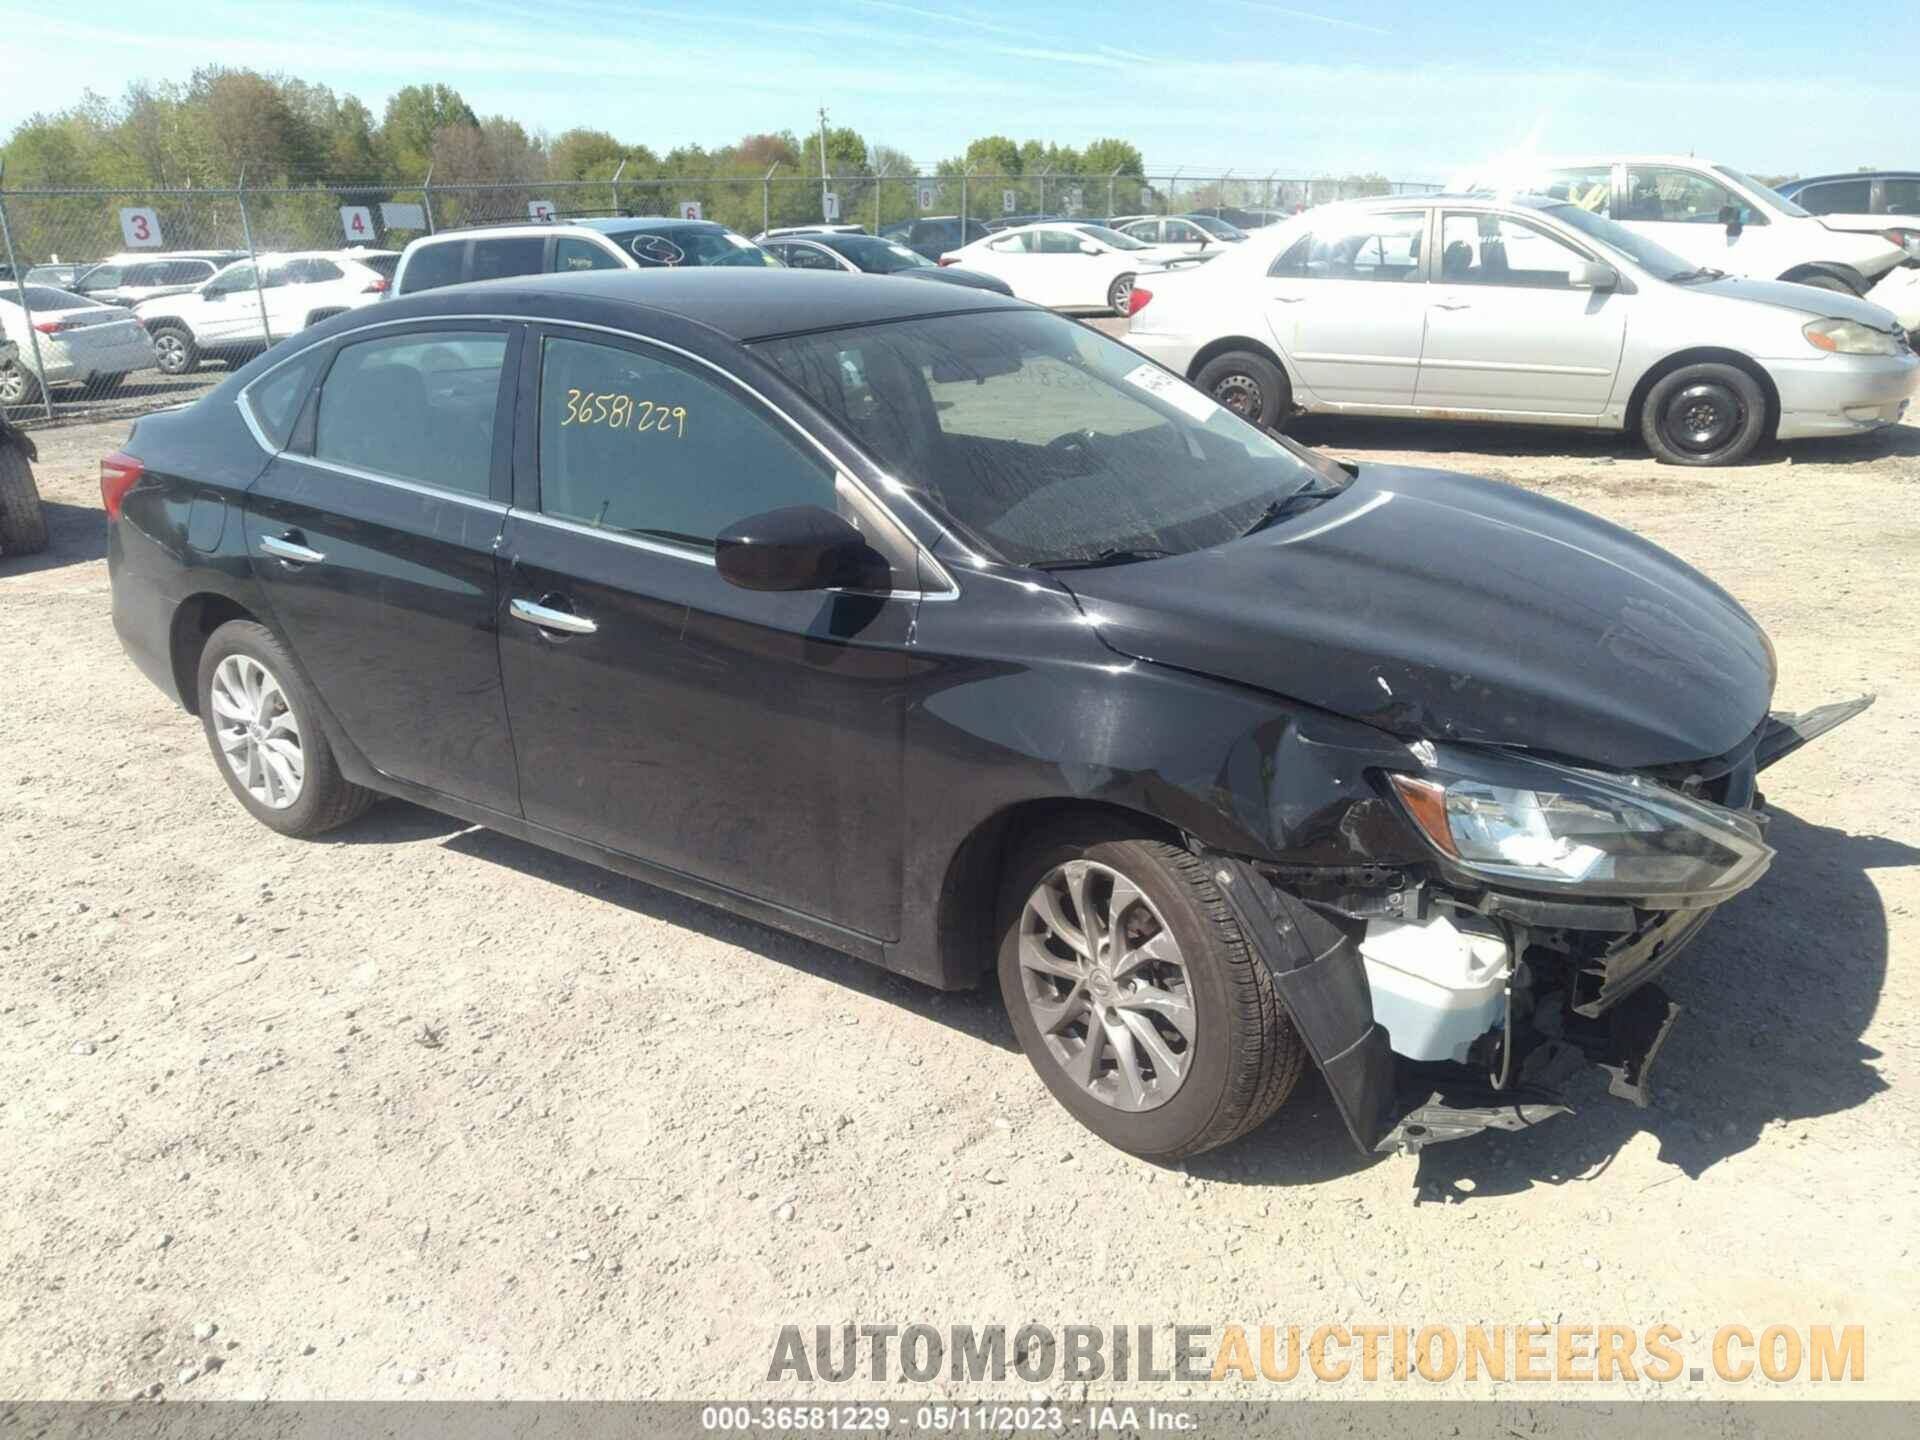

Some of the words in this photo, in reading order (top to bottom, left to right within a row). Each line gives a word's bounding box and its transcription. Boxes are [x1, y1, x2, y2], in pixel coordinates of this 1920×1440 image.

[827, 198, 834, 215] 7
[131, 215, 150, 240] 3
[351, 213, 365, 234] 4
[561, 389, 687, 438] 36581229
